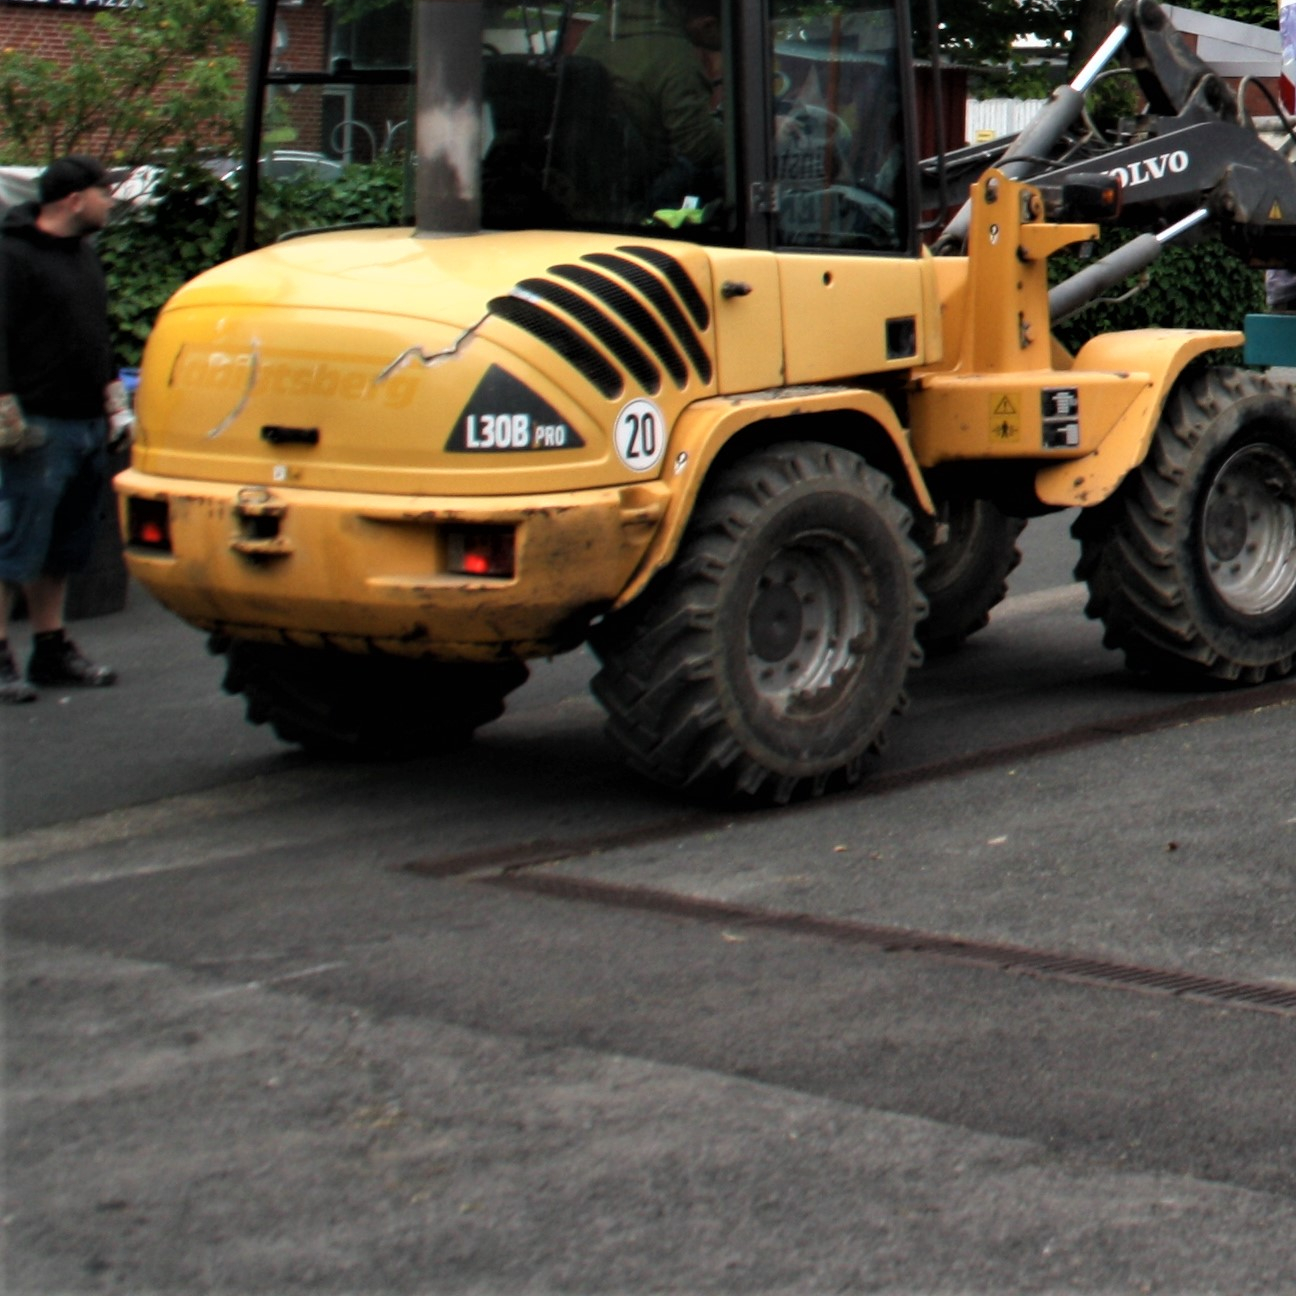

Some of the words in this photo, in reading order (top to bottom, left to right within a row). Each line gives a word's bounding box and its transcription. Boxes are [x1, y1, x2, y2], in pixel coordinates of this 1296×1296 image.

[1101, 150, 1189, 188] OLVO
[466, 413, 530, 449] L30B
[534, 424, 566, 448] PRO
[625, 412, 656, 459] 20
